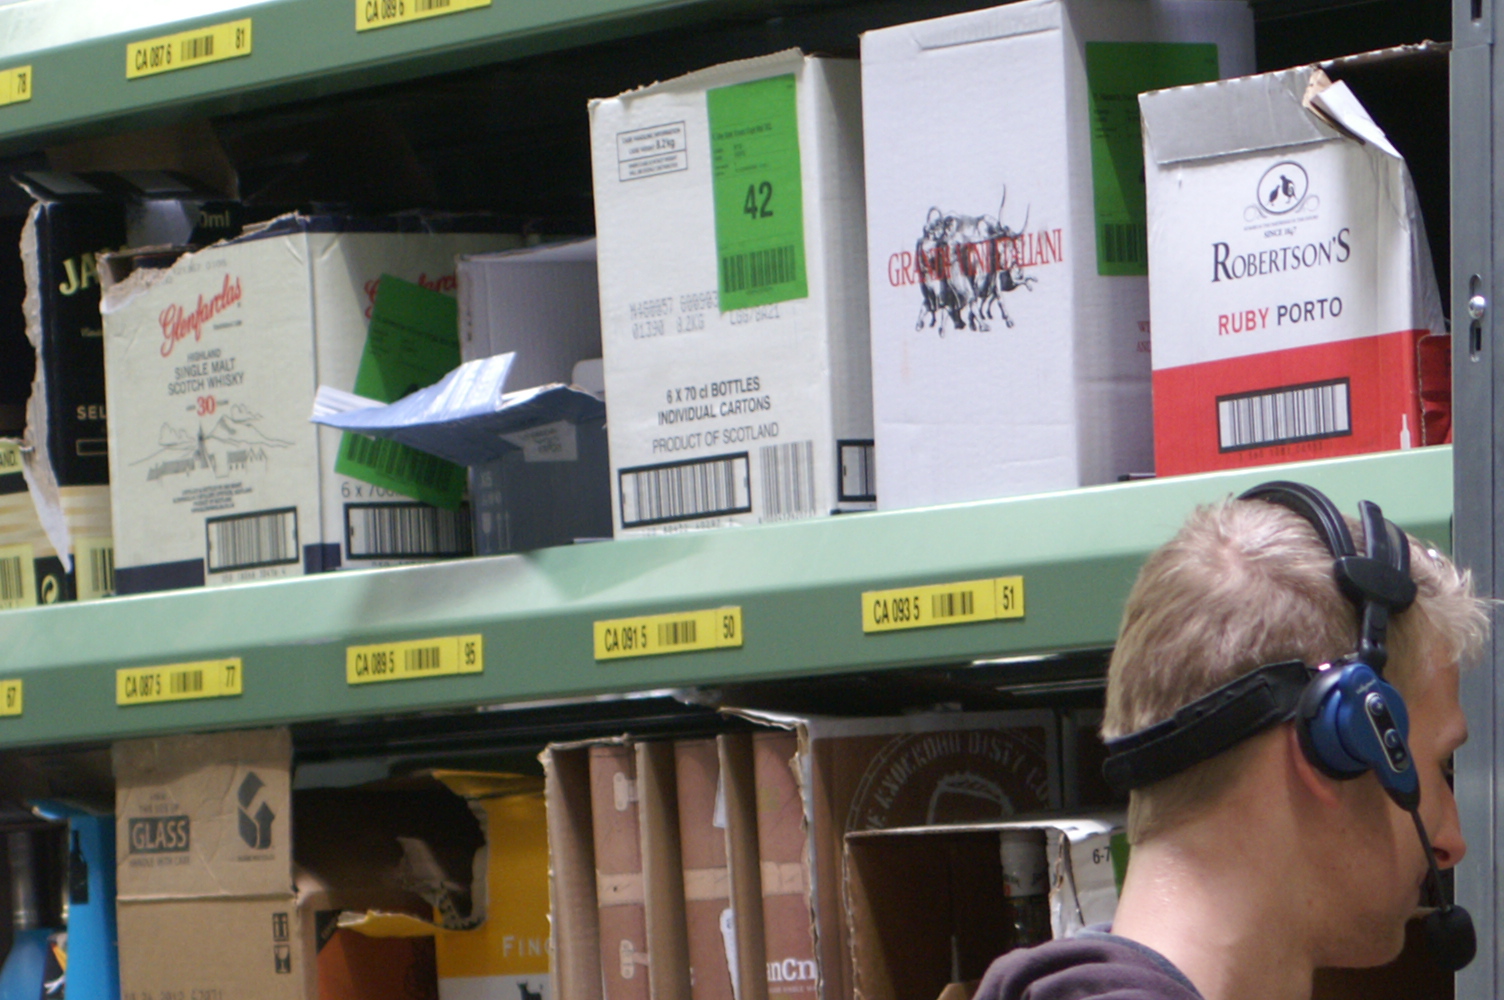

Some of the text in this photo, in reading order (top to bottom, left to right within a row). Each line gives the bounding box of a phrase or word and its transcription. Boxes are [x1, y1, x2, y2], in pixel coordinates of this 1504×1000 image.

[236, 28, 246, 49] 81
[744, 181, 773, 219] 42
[1211, 227, 1351, 283] ROBERTSON'S
[1218, 296, 1343, 336] RUBY PORTO
[174, 357, 236, 380] SINGLE MALT
[666, 389, 673, 404] 6
[675, 387, 684, 403] X
[685, 386, 697, 401] 70
[710, 376, 761, 398] BOTTLES
[196, 395, 215, 416] 30
[657, 396, 771, 426] INDIVIDUAL CARTONS
[652, 422, 779, 454] PRODUCT OF SCOTLAND
[873, 596, 920, 624] CA 093 5
[1003, 585, 1014, 610] 51
[605, 624, 647, 652] CA 091 5
[723, 615, 735, 639] 50
[355, 652, 370, 676] CA
[389, 650, 395, 673] 5
[464, 642, 476, 665] 95
[125, 675, 139, 698] CA
[226, 666, 237, 688] 77
[132, 820, 187, 849] GLASS
